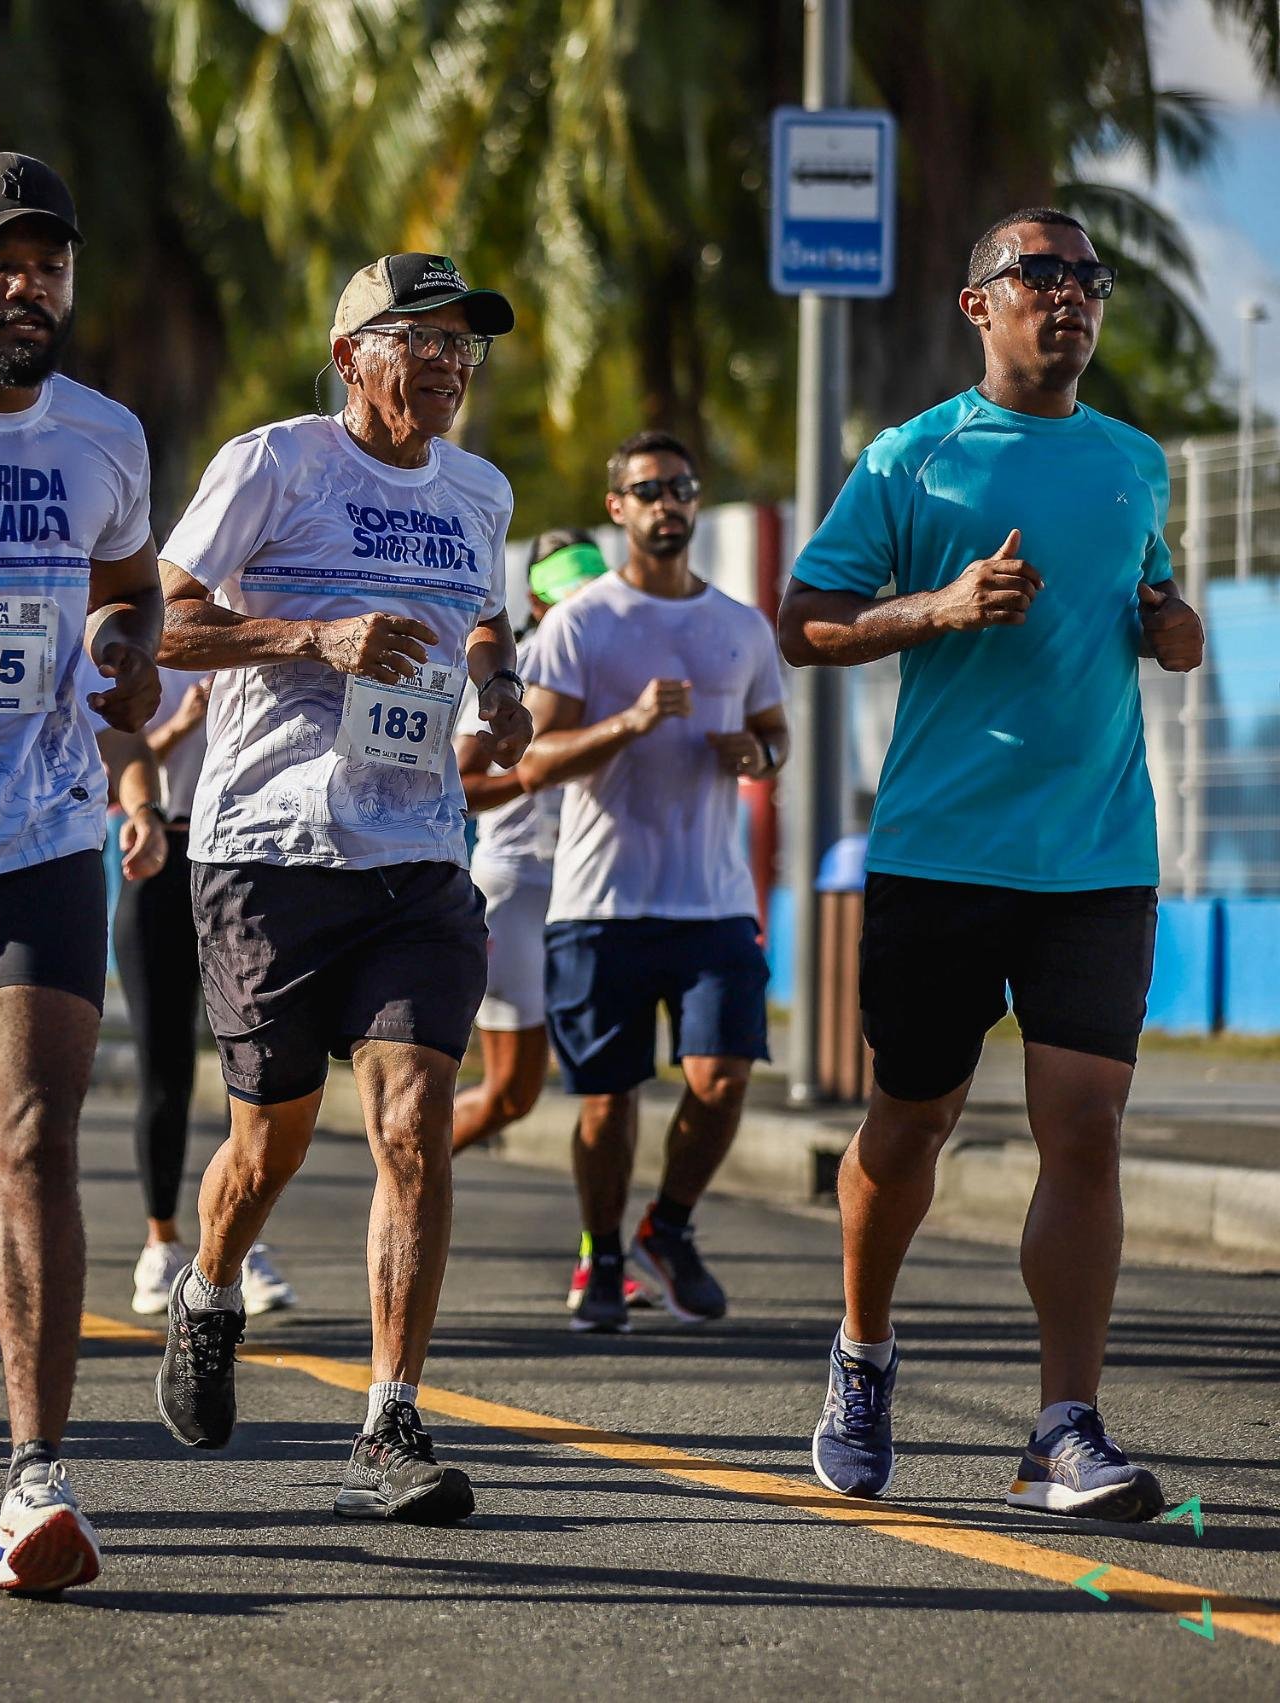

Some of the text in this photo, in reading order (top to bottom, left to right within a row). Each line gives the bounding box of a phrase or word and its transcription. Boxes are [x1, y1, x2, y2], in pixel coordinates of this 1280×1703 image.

[346, 502, 466, 541] CORRIDA
[351, 526, 478, 573] SAGRADA
[369, 702, 428, 743] 183
